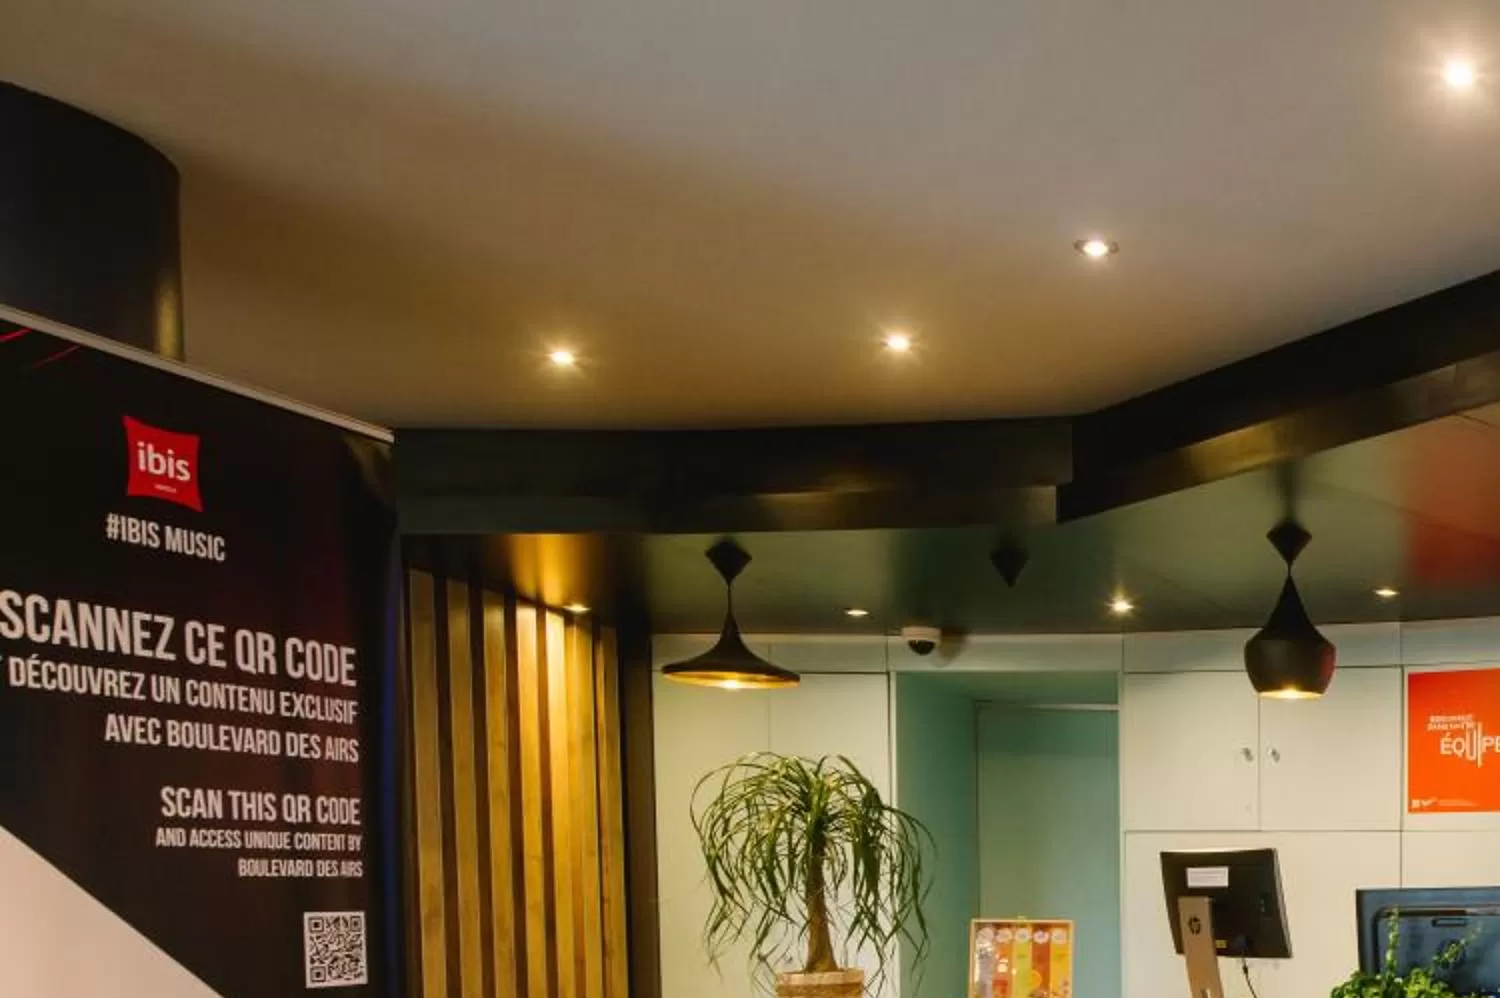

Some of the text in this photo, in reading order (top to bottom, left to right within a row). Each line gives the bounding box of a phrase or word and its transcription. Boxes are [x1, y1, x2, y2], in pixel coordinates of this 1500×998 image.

[137, 441, 191, 481] ibis
[106, 512, 225, 561] #IBIS MUSIC
[0, 589, 357, 687] SCANNEZ CE QR CODE
[8, 653, 359, 724] DÉCOUVREZ UN CONTENU EXCLUSIF
[105, 713, 359, 763] AVEC BOULEVARD DES AIRS
[161, 786, 361, 825] SCAN THIS QR CODE
[156, 828, 362, 851] AND ACCESS UNIQUE CONTENT BY
[238, 858, 363, 877] BOULEVARD DES AIRS
